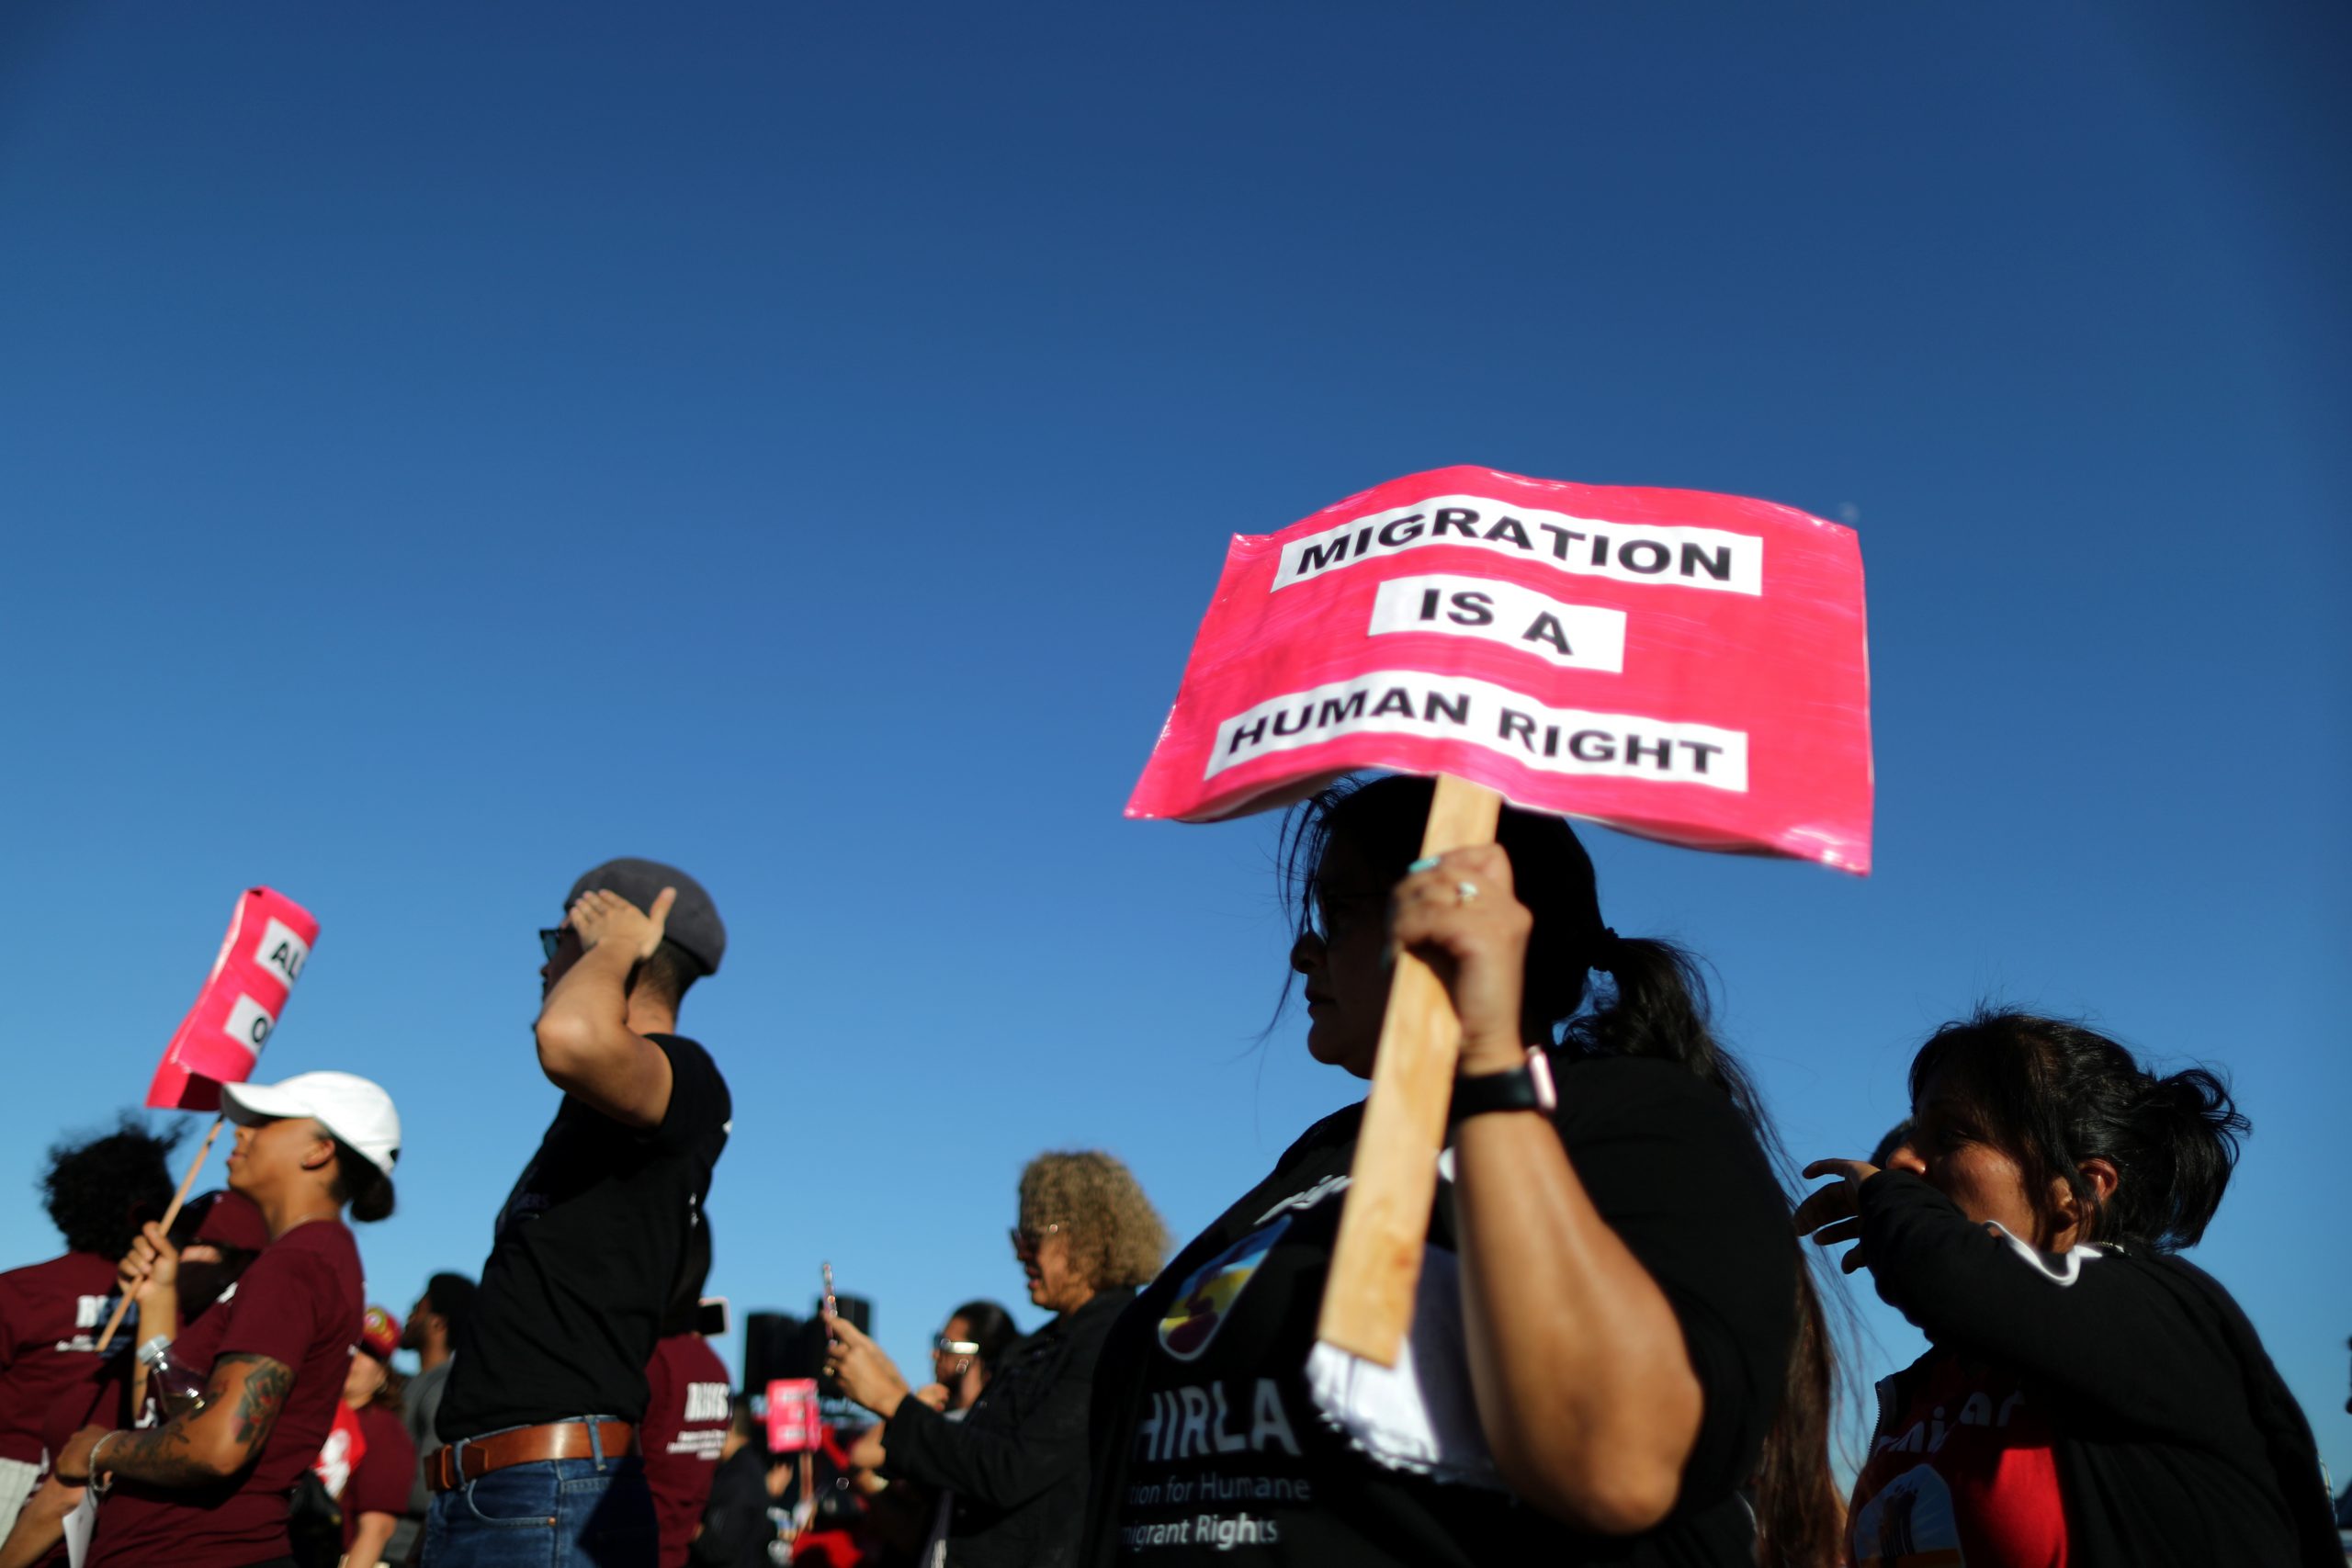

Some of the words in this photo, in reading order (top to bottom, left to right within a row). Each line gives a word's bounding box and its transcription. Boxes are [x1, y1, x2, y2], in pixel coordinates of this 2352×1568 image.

[1295, 506, 1733, 581] MIGRATION
[1419, 588, 1494, 626] IS
[1522, 610, 1574, 656] A
[1227, 685, 1470, 757] HUMAN
[1496, 706, 1722, 774] RIGHT
[1164, 1474, 1194, 1505] for
[1200, 1471, 1311, 1501] Humane
[1195, 1512, 1279, 1552] Rights
